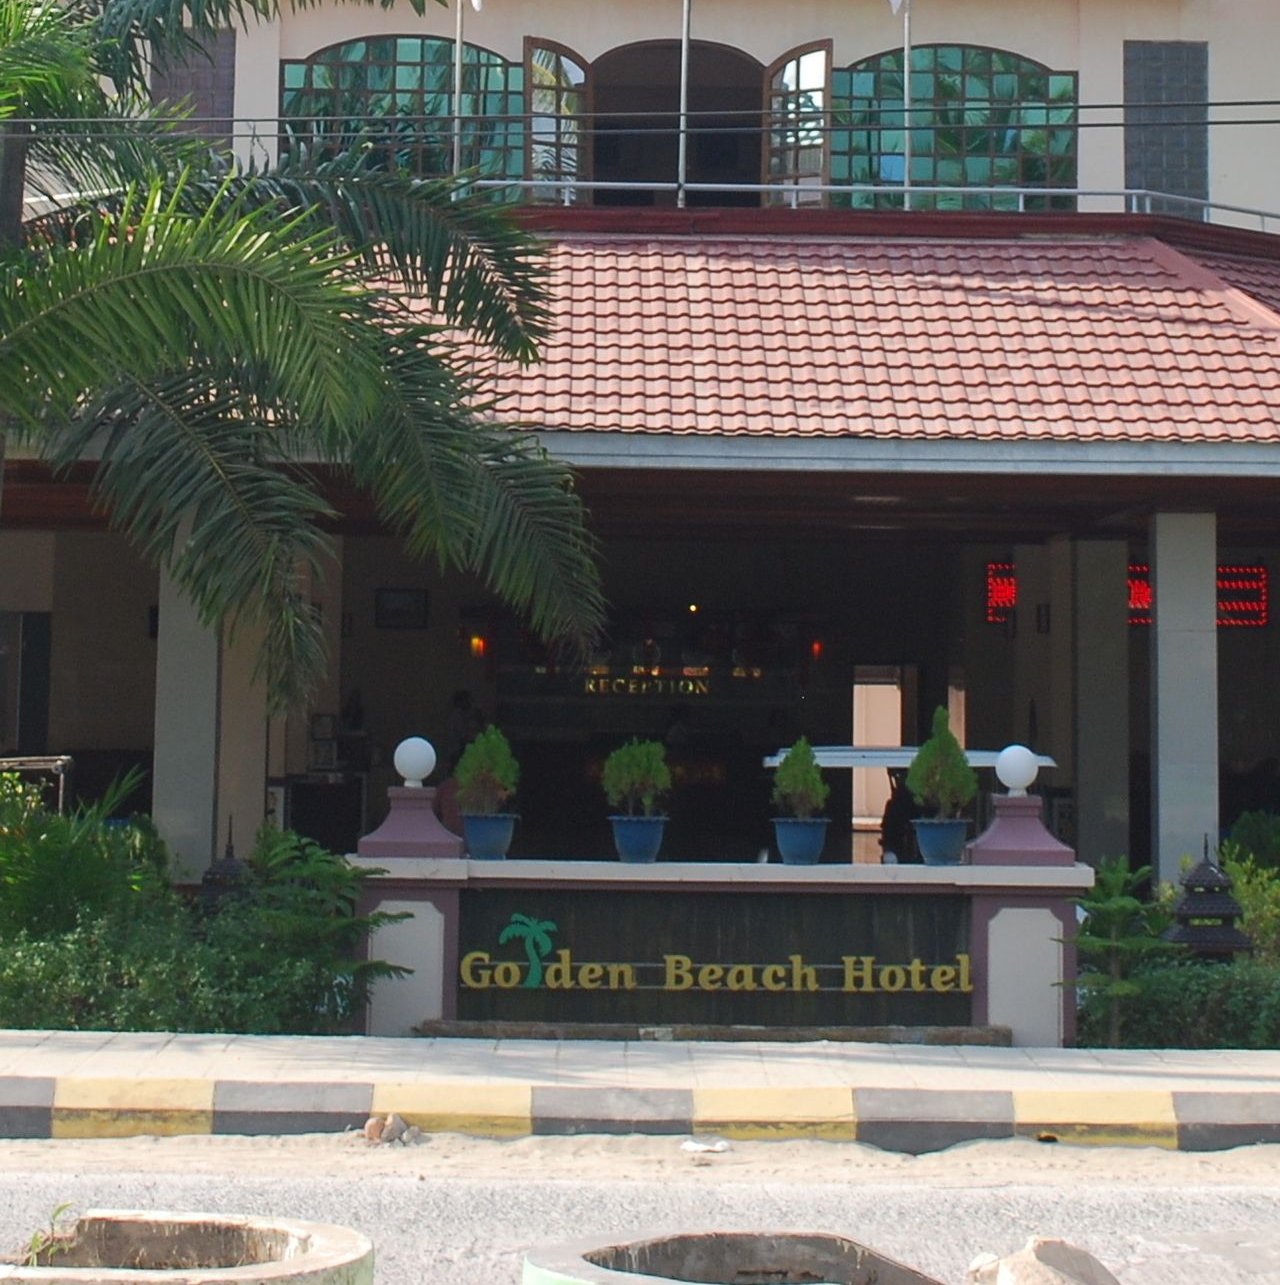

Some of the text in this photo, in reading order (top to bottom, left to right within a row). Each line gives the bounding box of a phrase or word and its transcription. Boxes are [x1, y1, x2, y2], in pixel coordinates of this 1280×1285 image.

[584, 678, 709, 694] RECEPTION
[460, 933, 974, 993] Golden Beach Hotel
